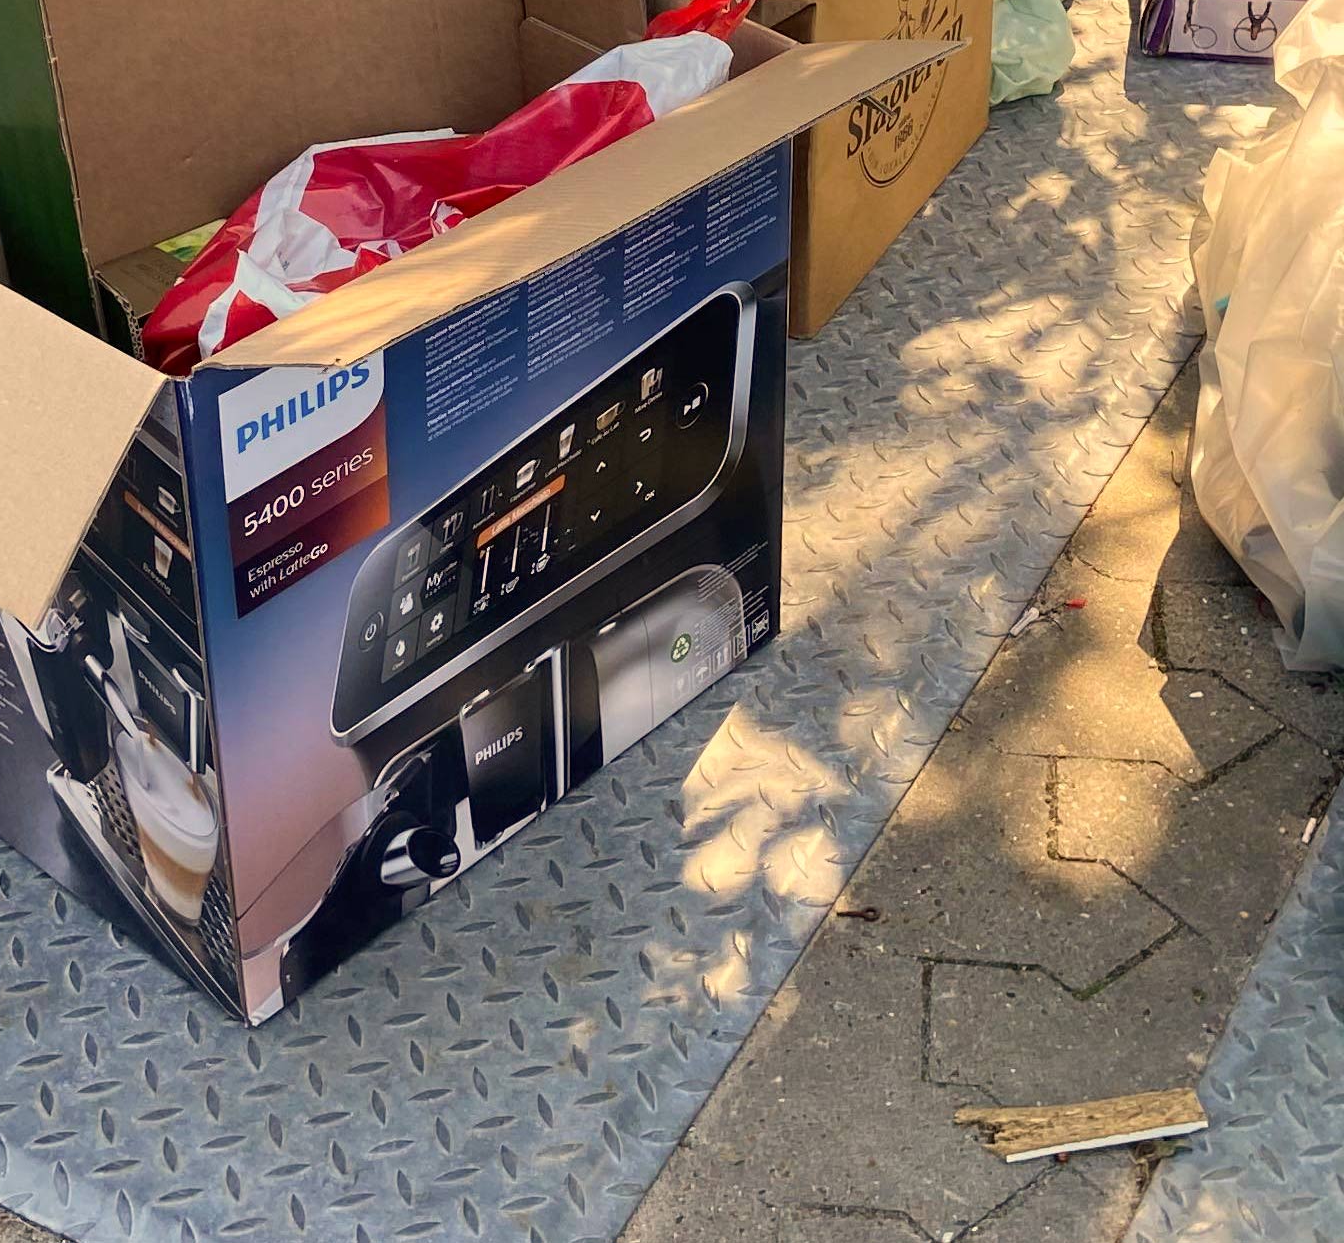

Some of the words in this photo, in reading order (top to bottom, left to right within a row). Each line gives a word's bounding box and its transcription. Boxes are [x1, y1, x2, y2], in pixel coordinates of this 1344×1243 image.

[236, 358, 370, 455] PHILIPS
[244, 485, 305, 537] 5400
[311, 446, 374, 496] series
[247, 541, 304, 583] Espresso
[249, 574, 278, 599] with
[279, 543, 329, 582] LatteGo
[137, 668, 177, 715] PHILIPS
[475, 726, 524, 766] PHILIPS
